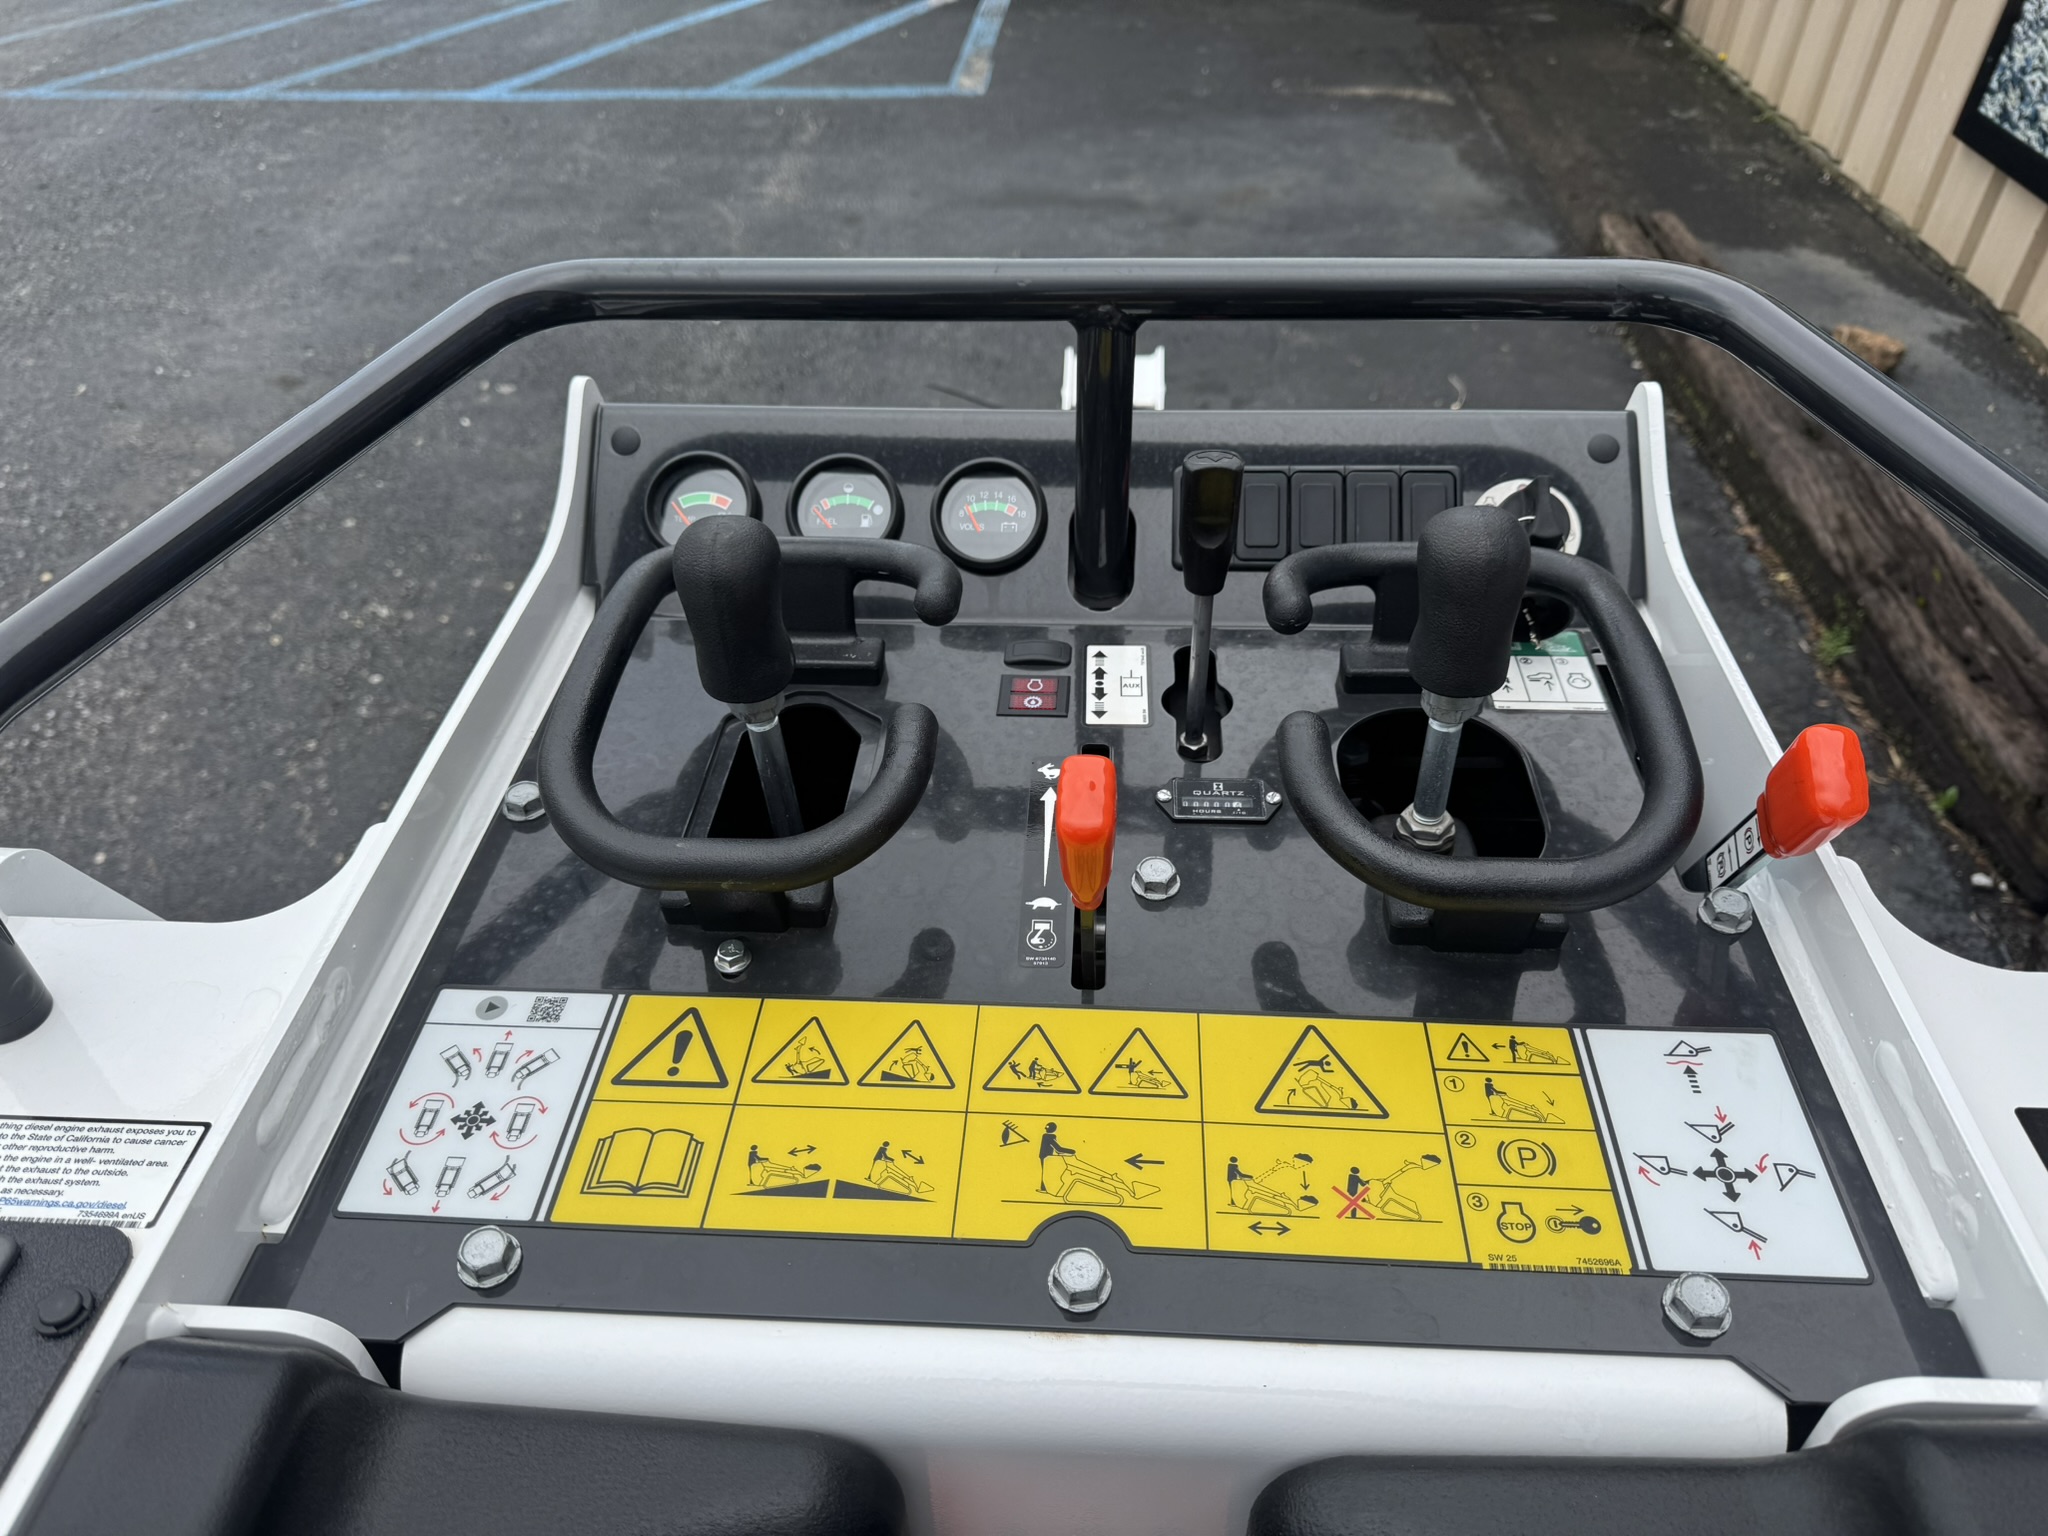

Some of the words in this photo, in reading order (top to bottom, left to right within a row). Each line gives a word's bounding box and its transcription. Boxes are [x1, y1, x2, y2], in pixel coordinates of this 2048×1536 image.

[966, 495, 976, 503] 10
[980, 491, 989, 499] 12
[994, 491, 1003, 499] 14
[1007, 495, 1017, 503] 16
[1017, 510, 1027, 518] 18
[959, 522, 985, 531] VOLS
[25, 1122, 54, 1131] diesel
[54, 1124, 86, 1134] engine
[87, 1125, 125, 1134] exhaust
[126, 1127, 166, 1136] exposes
[165, 1129, 185, 1137] you
[186, 1128, 197, 1136] to
[10, 1132, 26, 1140] the
[27, 1133, 53, 1141] State
[54, 1134, 66, 1142] of
[66, 1134, 111, 1144] California
[112, 1136, 122, 1144] to
[123, 1137, 153, 1145] cause
[154, 1138, 188, 1146] cancer
[2, 1143, 28, 1151] other
[28, 1144, 88, 1154] reproductive
[88, 1146, 115, 1154] harm.
[3, 1154, 19, 1162] the
[20, 1155, 53, 1164] engine
[74, 1156, 97, 1165] well-
[98, 1158, 146, 1167] ventilated
[5, 1165, 22, 1173] the
[22, 1165, 61, 1175] exhaust
[62, 1167, 73, 1175] to
[74, 1167, 90, 1175] the
[91, 1168, 129, 1177] outside.
[7, 1176, 24, 1184] the
[25, 1176, 64, 1185] exhaust
[64, 1178, 101, 1187] system.
[0, 1187, 13, 1195] as
[14, 1187, 65, 1197] necessary.
[121, 1211, 147, 1220] enUS
[1500, 1221, 1533, 1232] STOP
[1488, 1253, 1503, 1262] SW
[1506, 1254, 1518, 1263] 25
[1576, 1257, 1622, 1267] 7452696A
